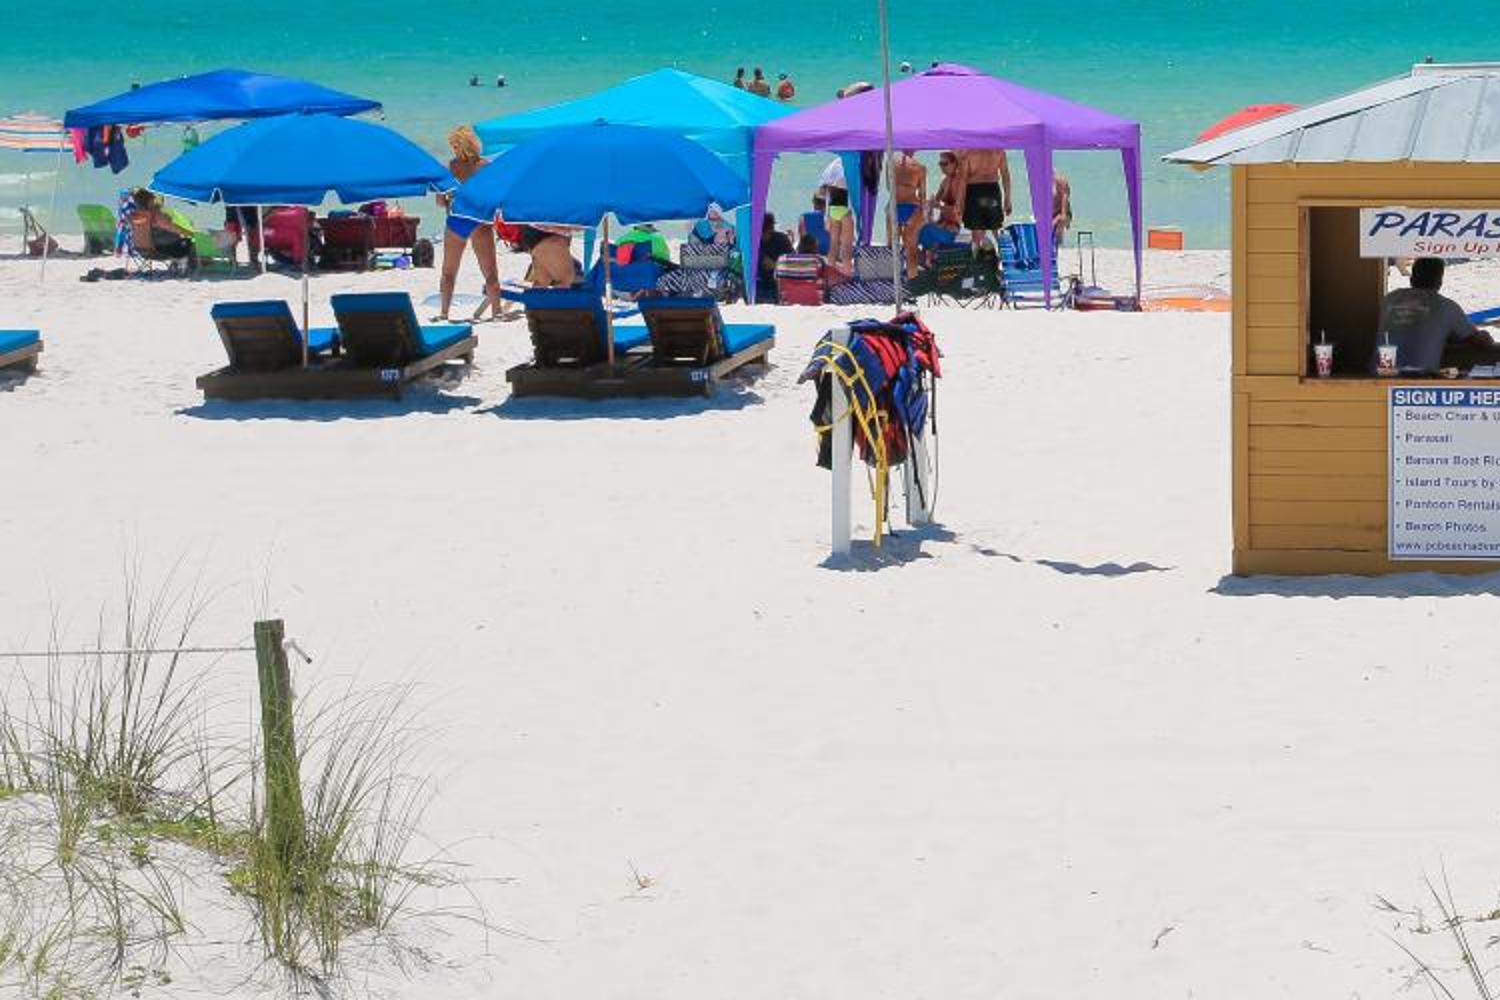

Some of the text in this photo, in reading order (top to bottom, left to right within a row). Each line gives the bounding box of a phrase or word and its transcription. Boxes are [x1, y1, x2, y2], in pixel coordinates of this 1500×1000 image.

[1413, 242, 1457, 255] Sign
[1464, 242, 1490, 254] Up
[1395, 391, 1437, 405] SIGN
[1442, 391, 1465, 405] UP
[1405, 410, 1442, 421] Beach
[1445, 410, 1477, 422] Chair
[1480, 411, 1489, 421] &
[1405, 433, 1453, 443] Parasail
[1405, 455, 1449, 465] Banana
[1453, 455, 1480, 466] Boat
[1405, 477, 1441, 487] Island
[1444, 477, 1478, 488] Tours
[1481, 478, 1496, 490] by
[1405, 499, 1455, 510] Pontoon
[1405, 521, 1488, 533] Beach Photos
